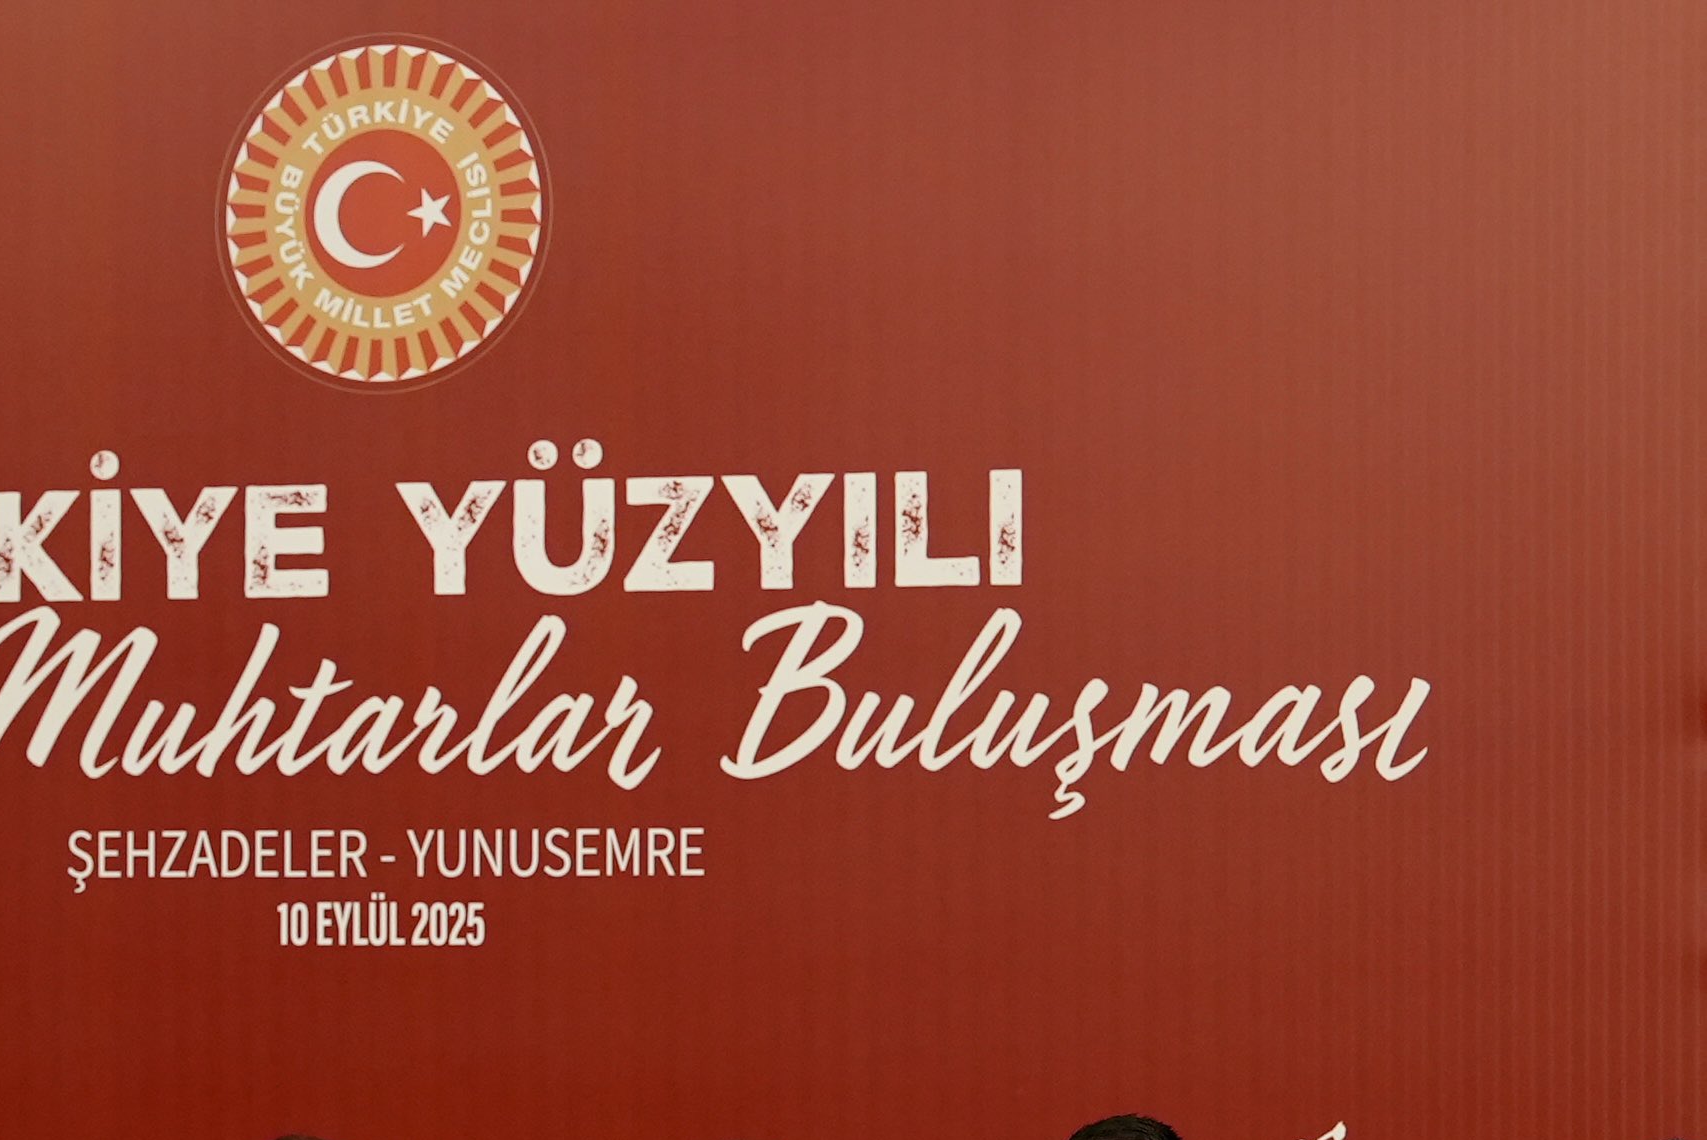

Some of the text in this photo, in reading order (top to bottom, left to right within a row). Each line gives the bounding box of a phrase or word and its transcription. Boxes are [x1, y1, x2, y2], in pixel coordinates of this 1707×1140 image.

[301, 98, 455, 155] TÜRKİYE
[275, 164, 314, 290] BÜYÜK
[314, 287, 433, 328] MİLLET
[395, 438, 1023, 596] YÜZYILI
[720, 600, 1431, 820] Buluşması
[67, 829, 367, 893] ŞEHZADELER
[407, 827, 705, 878] YUNUSEMRE
[277, 892, 485, 947] 10 EYLÜL 2025
